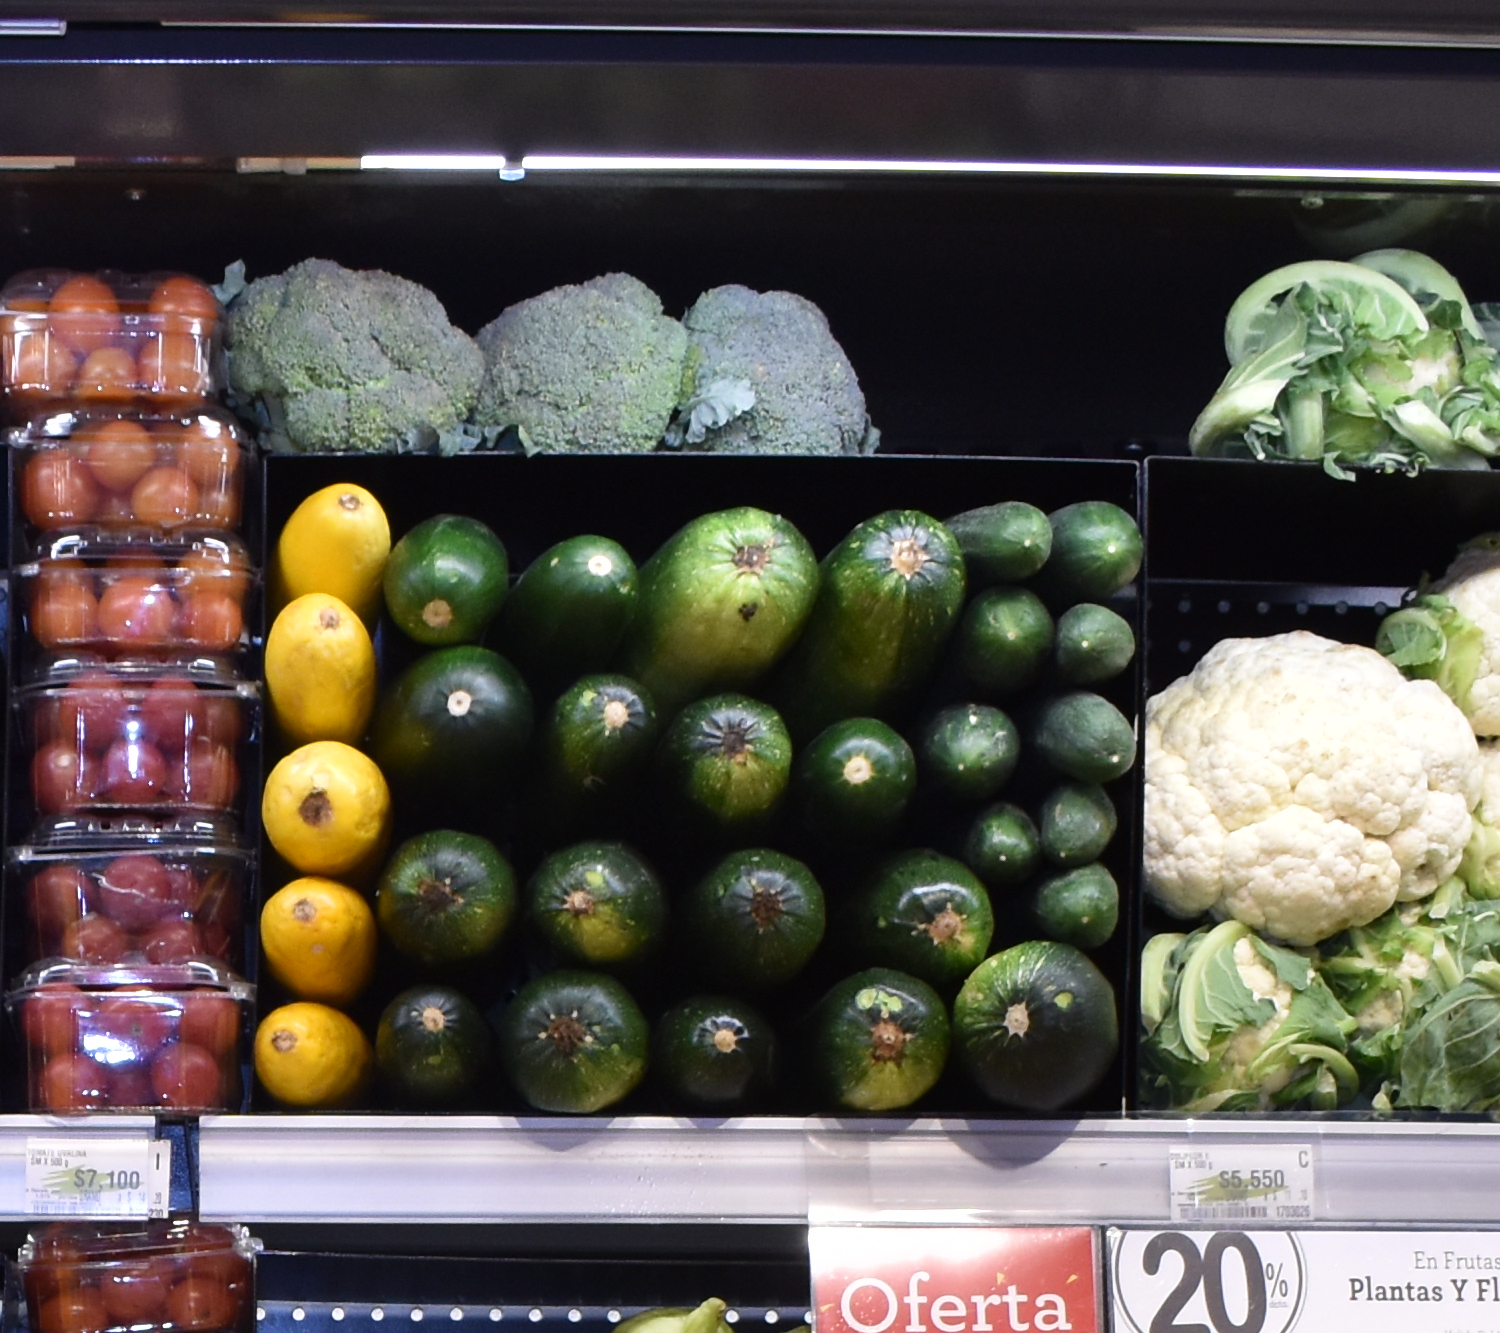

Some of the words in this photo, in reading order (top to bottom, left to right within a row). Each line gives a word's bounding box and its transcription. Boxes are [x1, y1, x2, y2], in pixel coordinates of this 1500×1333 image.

[1298, 1151, 1309, 1167] C
[74, 1170, 140, 1189] $7,100
[1219, 1169, 1284, 1188] $5,550
[1414, 1251, 1438, 1270] En
[1349, 1278, 1442, 1303] Plantas
[1450, 1279, 1468, 1301] Y
[840, 1271, 1072, 1333] Oferta
